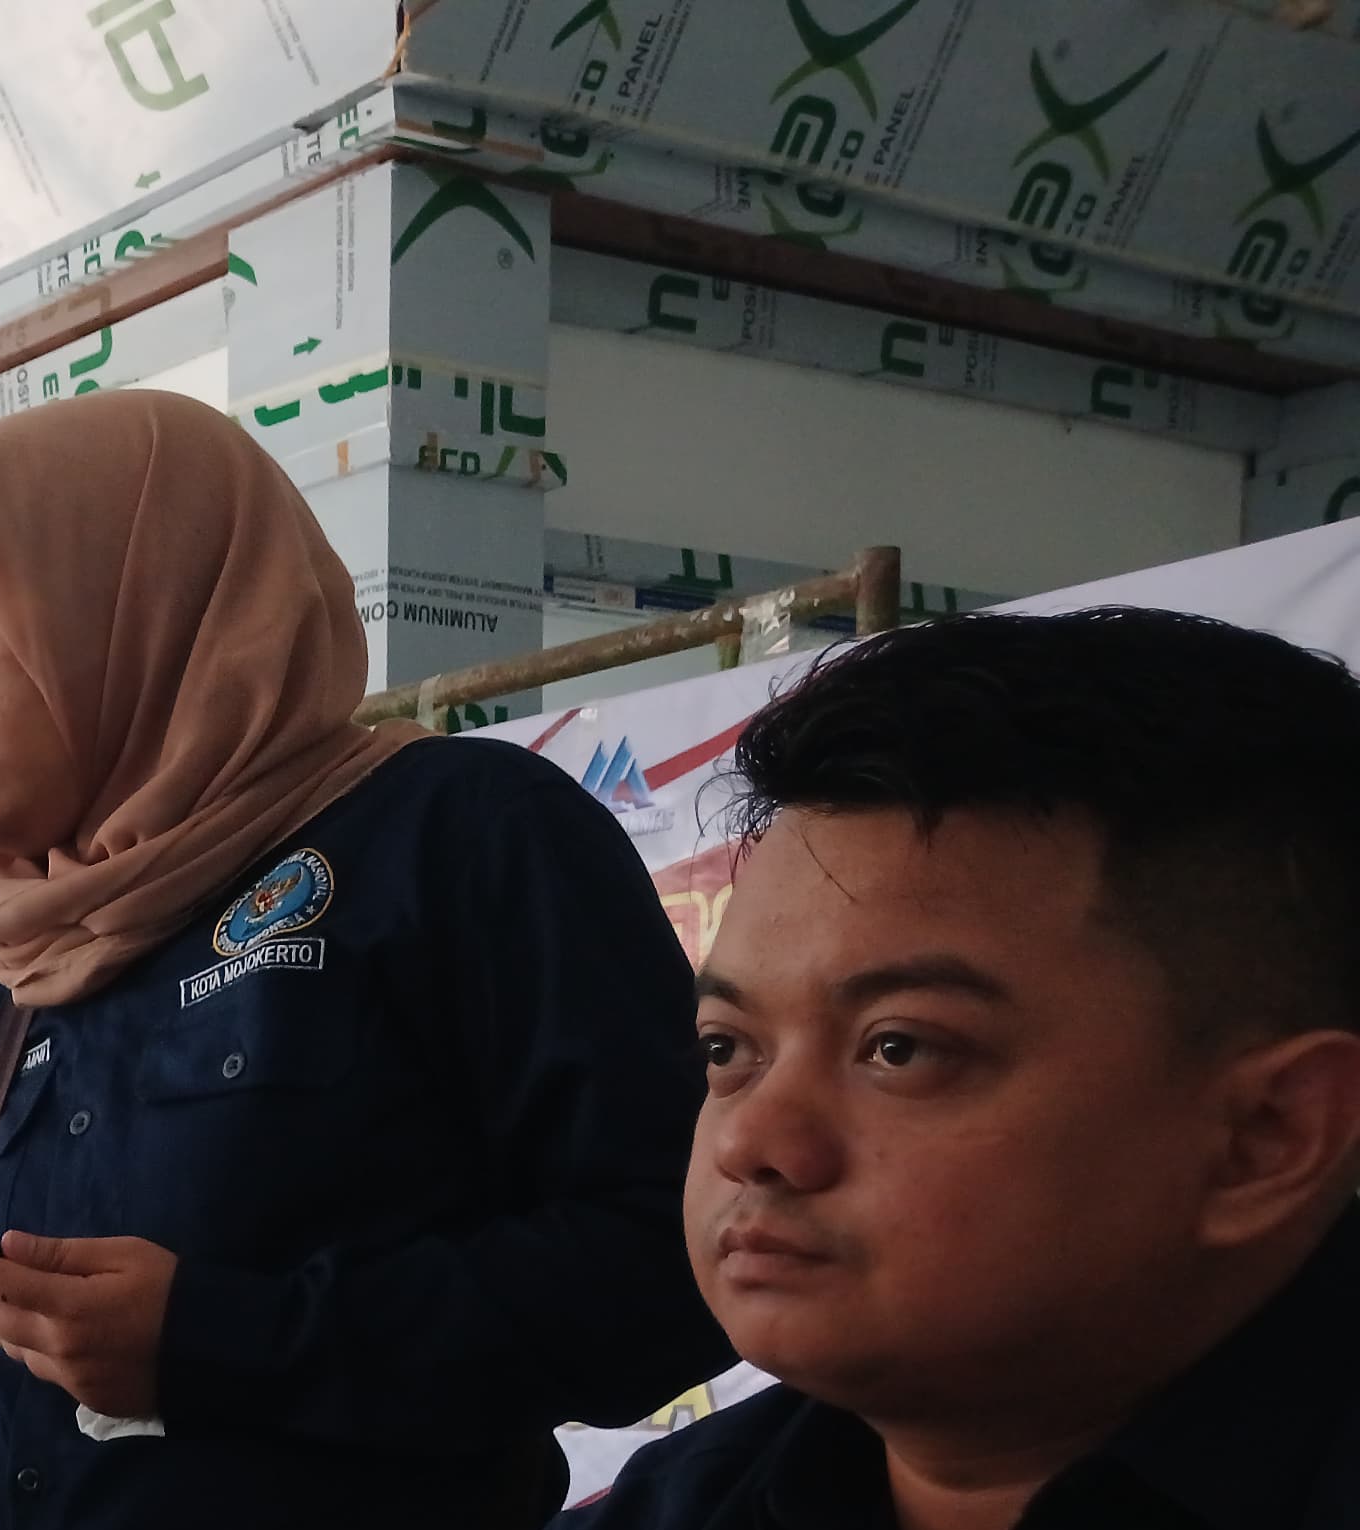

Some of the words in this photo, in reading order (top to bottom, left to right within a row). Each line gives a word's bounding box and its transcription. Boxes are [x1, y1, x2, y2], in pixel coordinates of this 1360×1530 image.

[403, 601, 499, 633] ALUMINUM
[190, 975, 222, 1001] KOTA
[223, 943, 314, 986] MOJOKERTO
